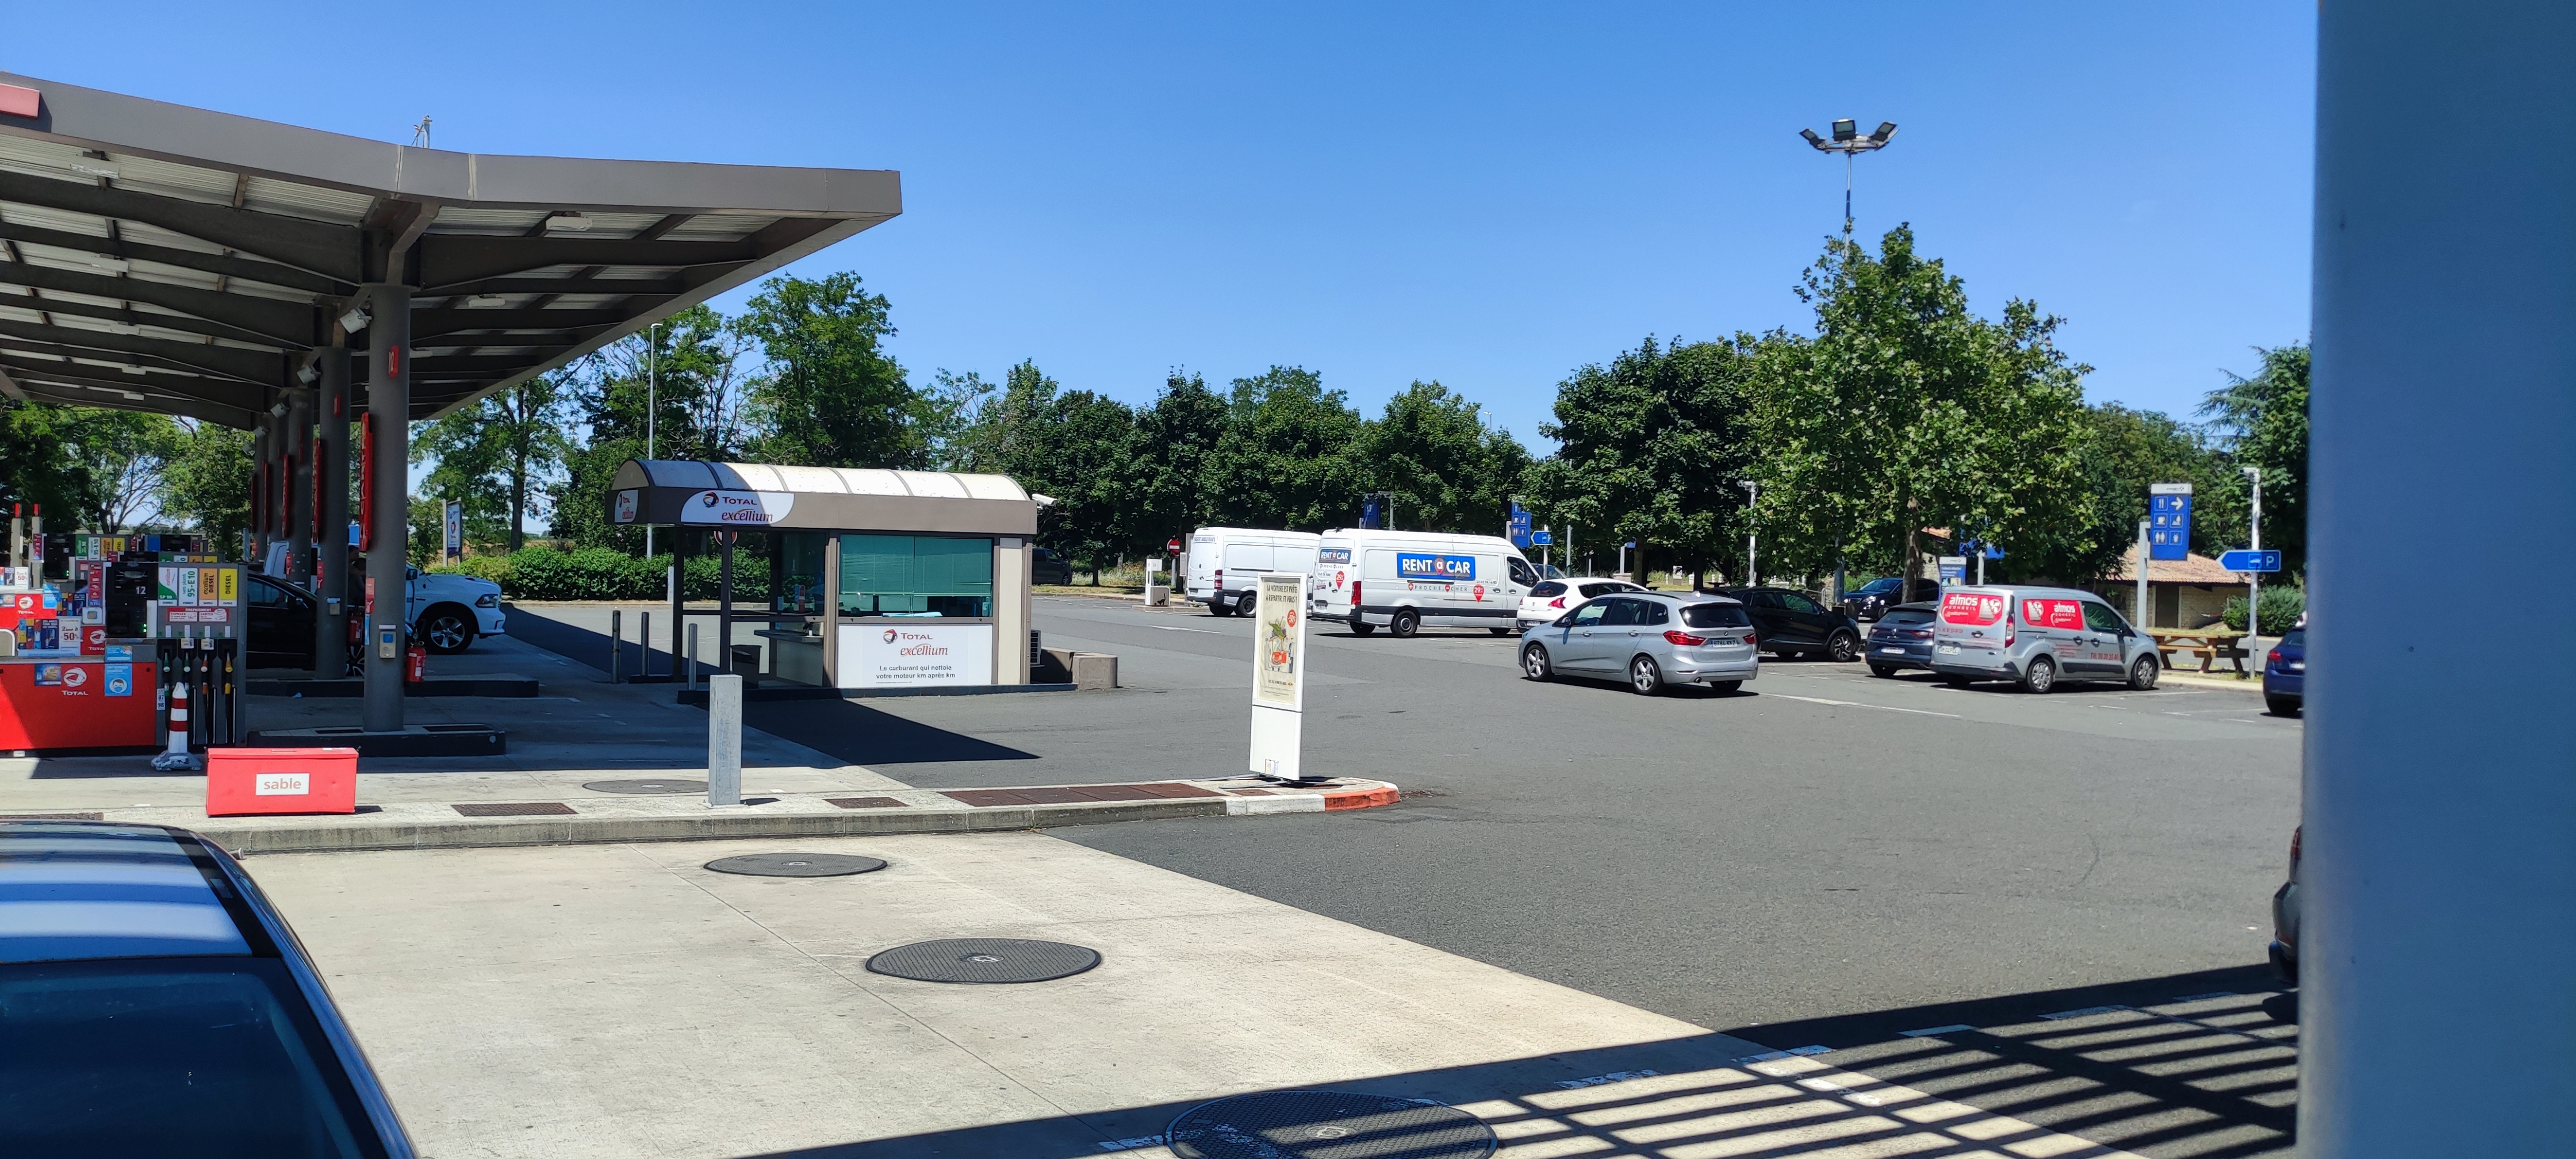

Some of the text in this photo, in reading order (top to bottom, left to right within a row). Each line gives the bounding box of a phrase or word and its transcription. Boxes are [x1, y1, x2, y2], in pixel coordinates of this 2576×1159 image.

[722, 497, 757, 505] TOTAL
[722, 509, 773, 522] excellium
[1402, 558, 1470, 574] RENT a CAR
[2266, 556, 2274, 566] P
[136, 586, 146, 594] 12
[1949, 594, 1978, 607] atmos
[2054, 602, 2075, 613] atmos
[900, 644, 948, 656] excellium
[927, 672, 944, 680] après
[264, 778, 301, 790] sable
